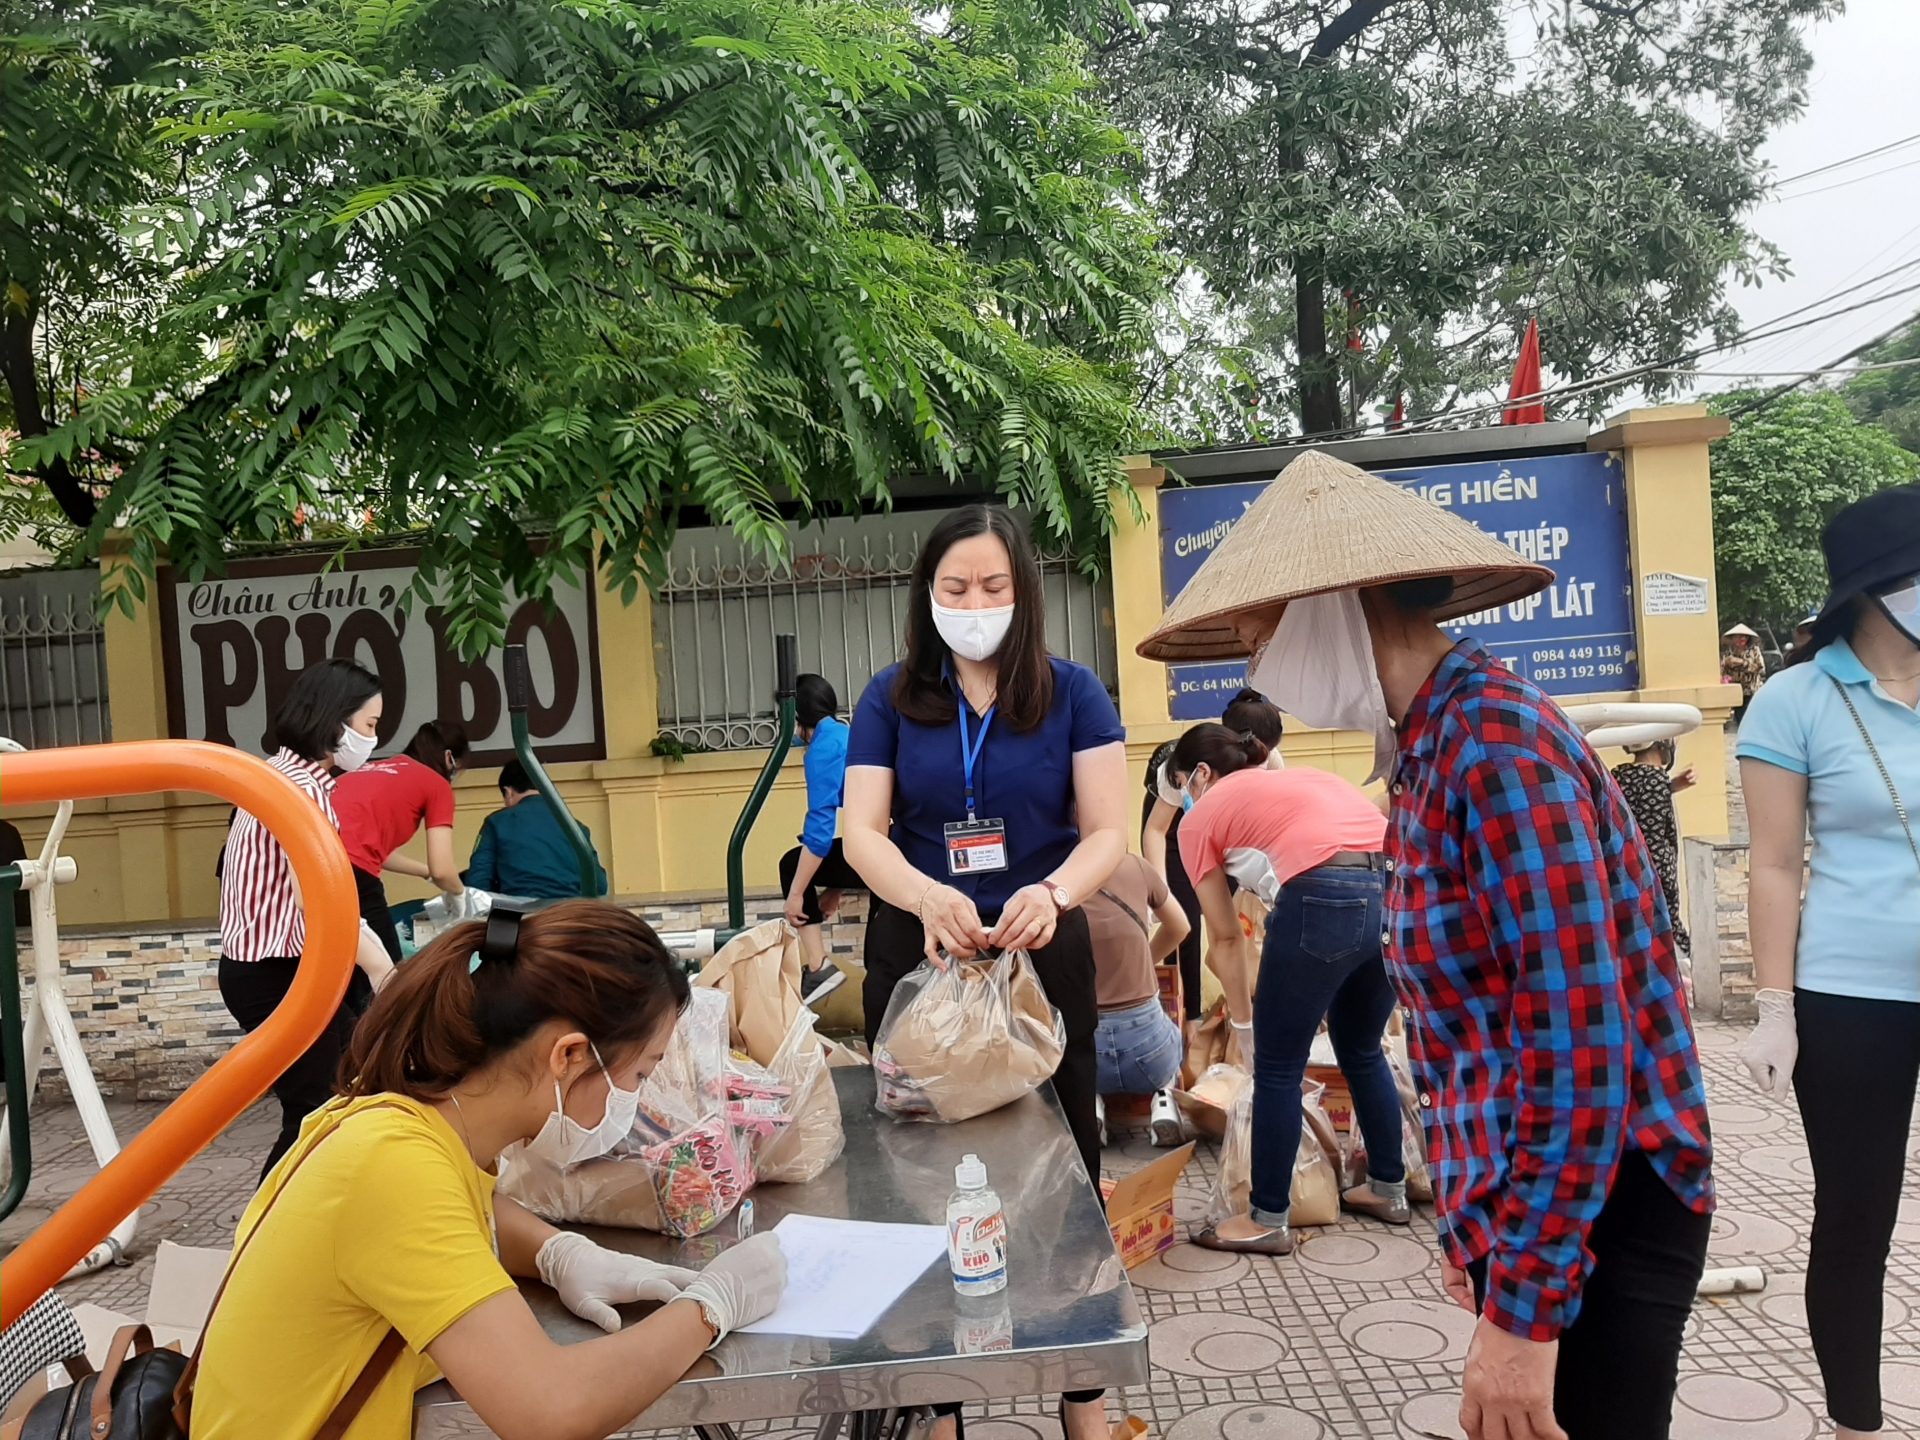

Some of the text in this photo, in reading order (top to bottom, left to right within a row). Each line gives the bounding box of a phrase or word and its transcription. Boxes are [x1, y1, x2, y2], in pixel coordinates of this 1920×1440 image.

[1460, 469, 1538, 505] HIỀN
[1504, 520, 1569, 562] THÉP
[187, 582, 277, 618] Châu
[1550, 576, 1596, 619] LÁT
[190, 585, 406, 757] PHỞ
[1532, 644, 1622, 663] 0984 449 118
[1181, 677, 1244, 692] ĐC: 64 KIM
[1534, 663, 1623, 681] 0913 192 996
